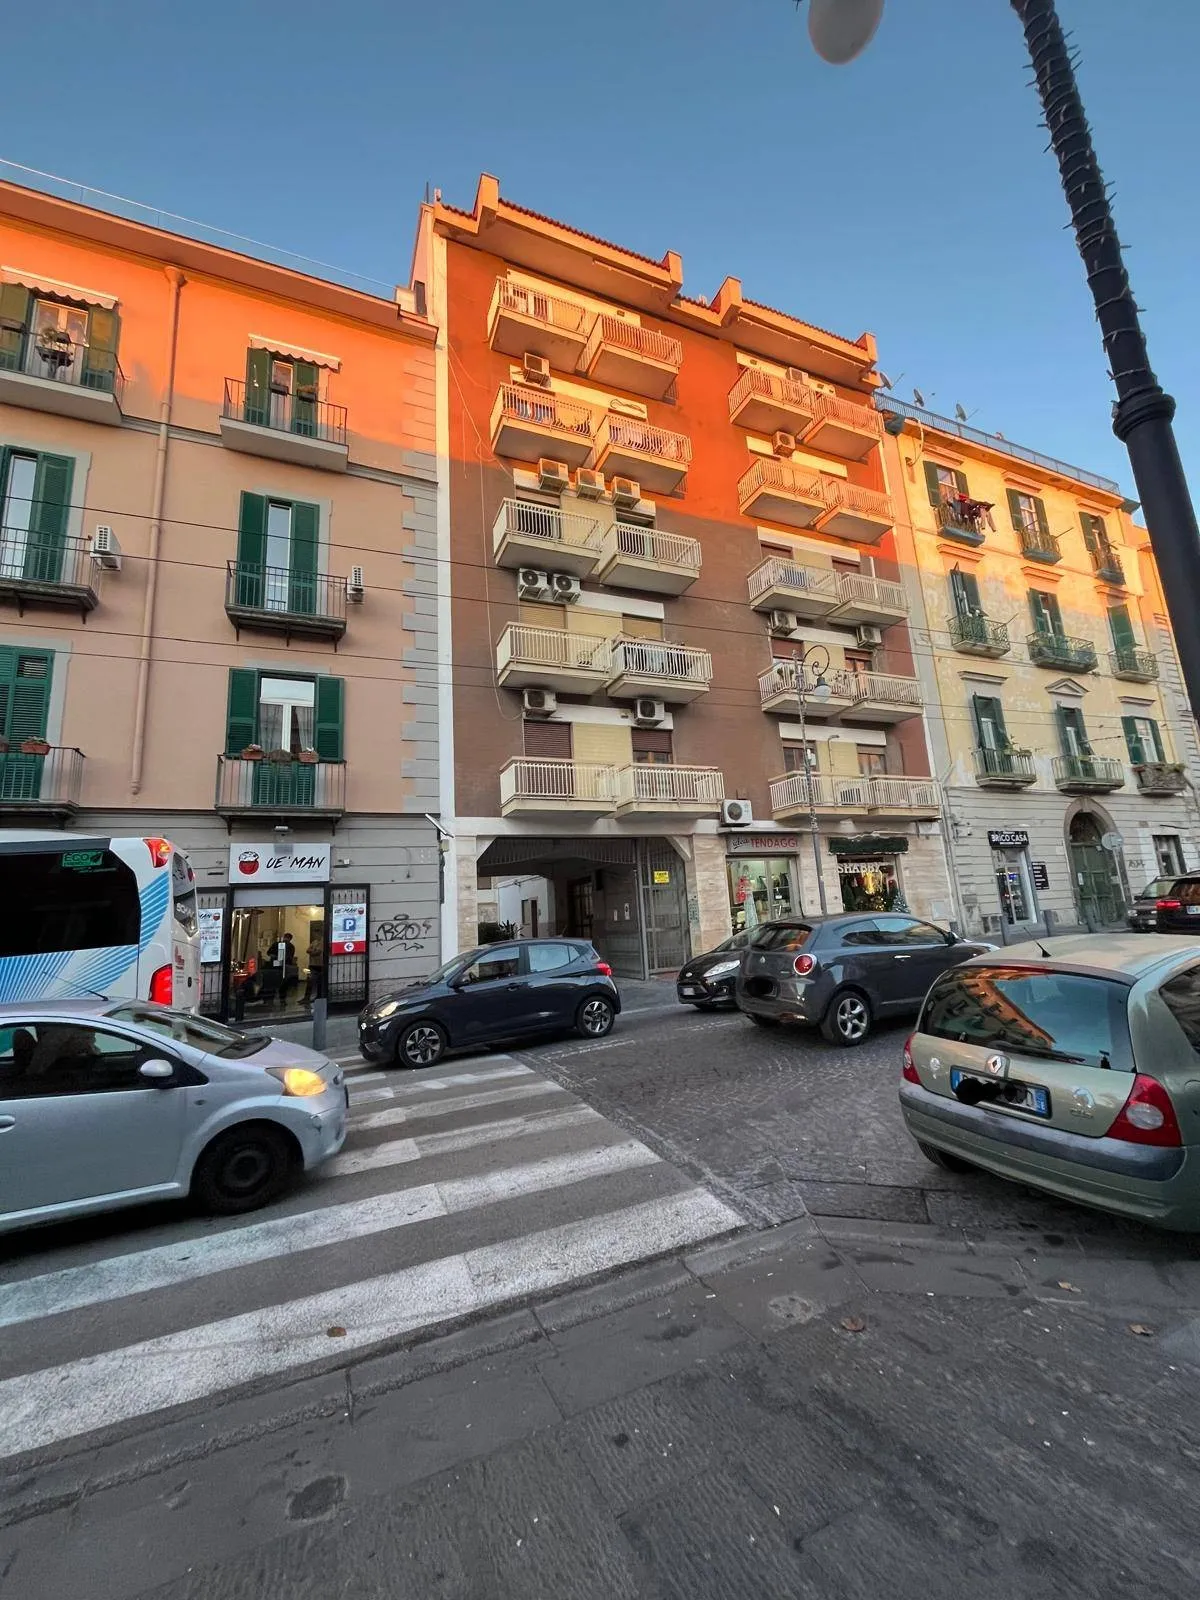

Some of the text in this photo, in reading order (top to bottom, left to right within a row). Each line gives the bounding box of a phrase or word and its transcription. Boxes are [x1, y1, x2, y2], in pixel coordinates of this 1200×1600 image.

[750, 837, 798, 848] TENDAGGI
[991, 834, 1028, 842] BRICO CASA
[837, 862, 881, 873] SHABBY
[345, 919, 354, 930] P
